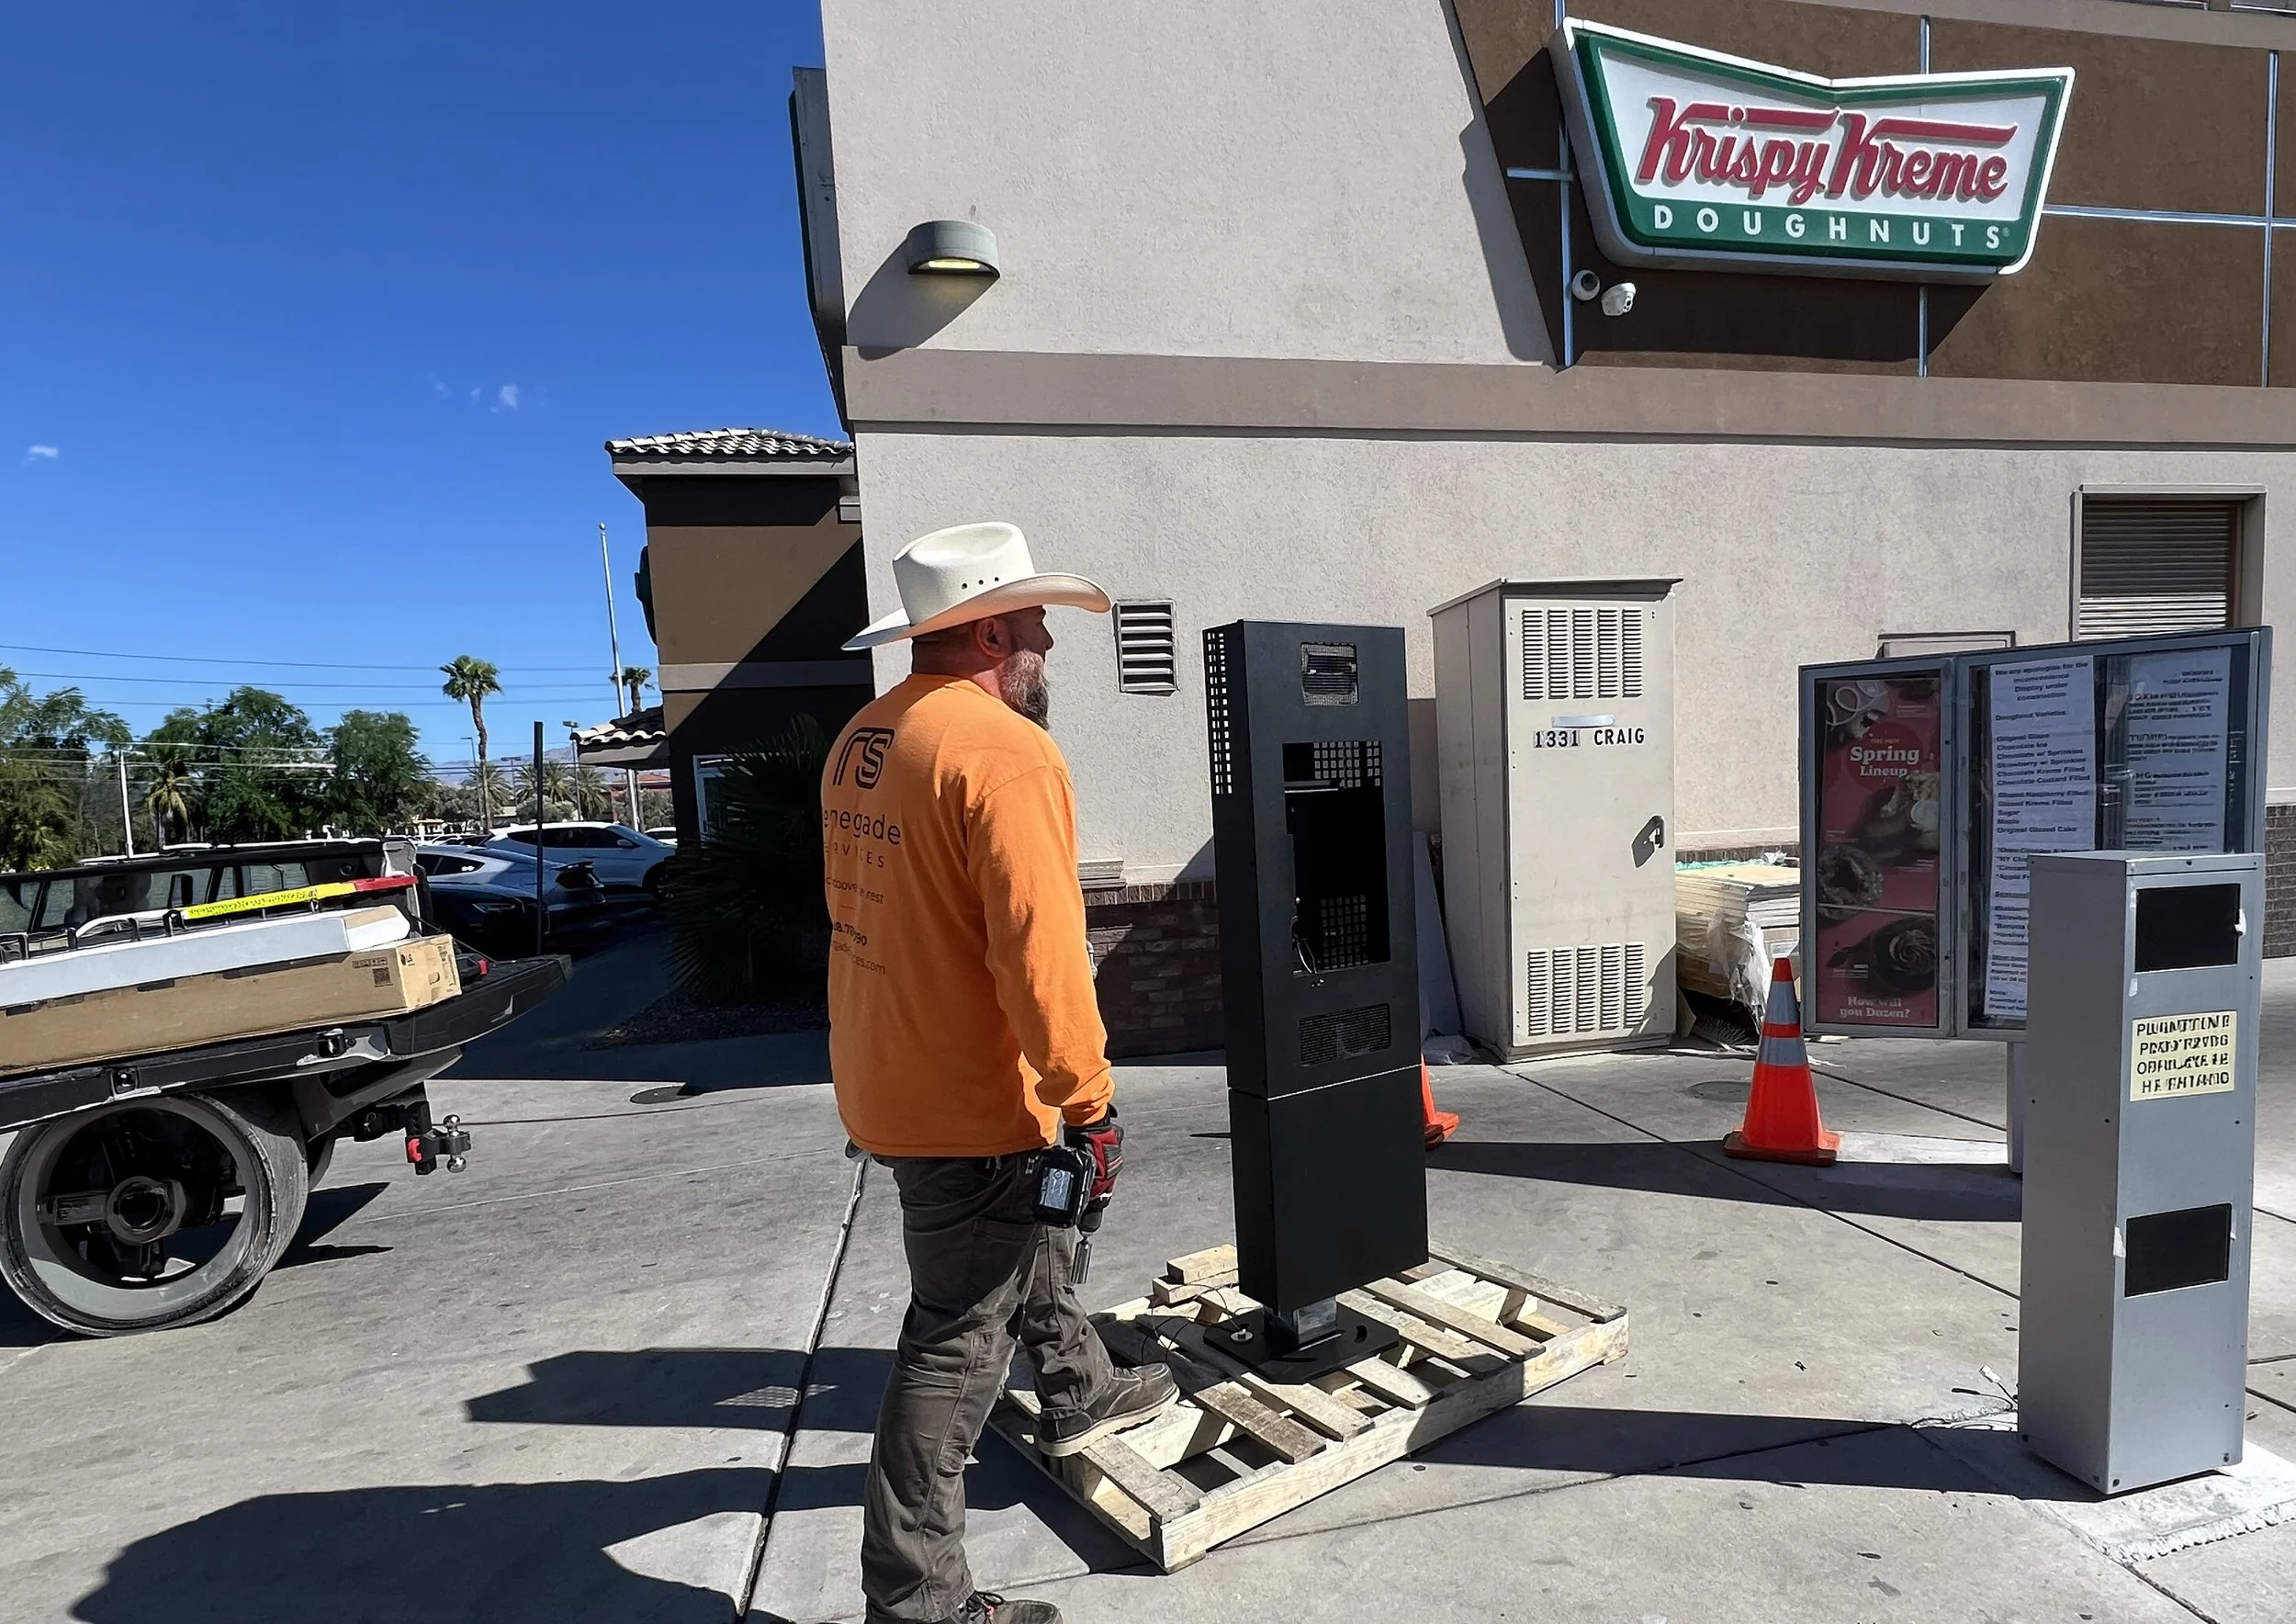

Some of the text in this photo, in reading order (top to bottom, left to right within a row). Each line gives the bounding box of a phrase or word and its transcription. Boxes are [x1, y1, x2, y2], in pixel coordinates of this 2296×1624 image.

[1634, 96, 2019, 206] Krispy Kreme
[1654, 204, 2001, 250] DOUGHNUTS
[1534, 727, 1645, 749] 1331 CRAIG
[1850, 745, 1919, 765] Spring
[1860, 765, 1908, 778] Lineup
[824, 808, 901, 845] enegade
[1848, 996, 1874, 1006] How
[1840, 1007, 1911, 1018] you Dozen?
